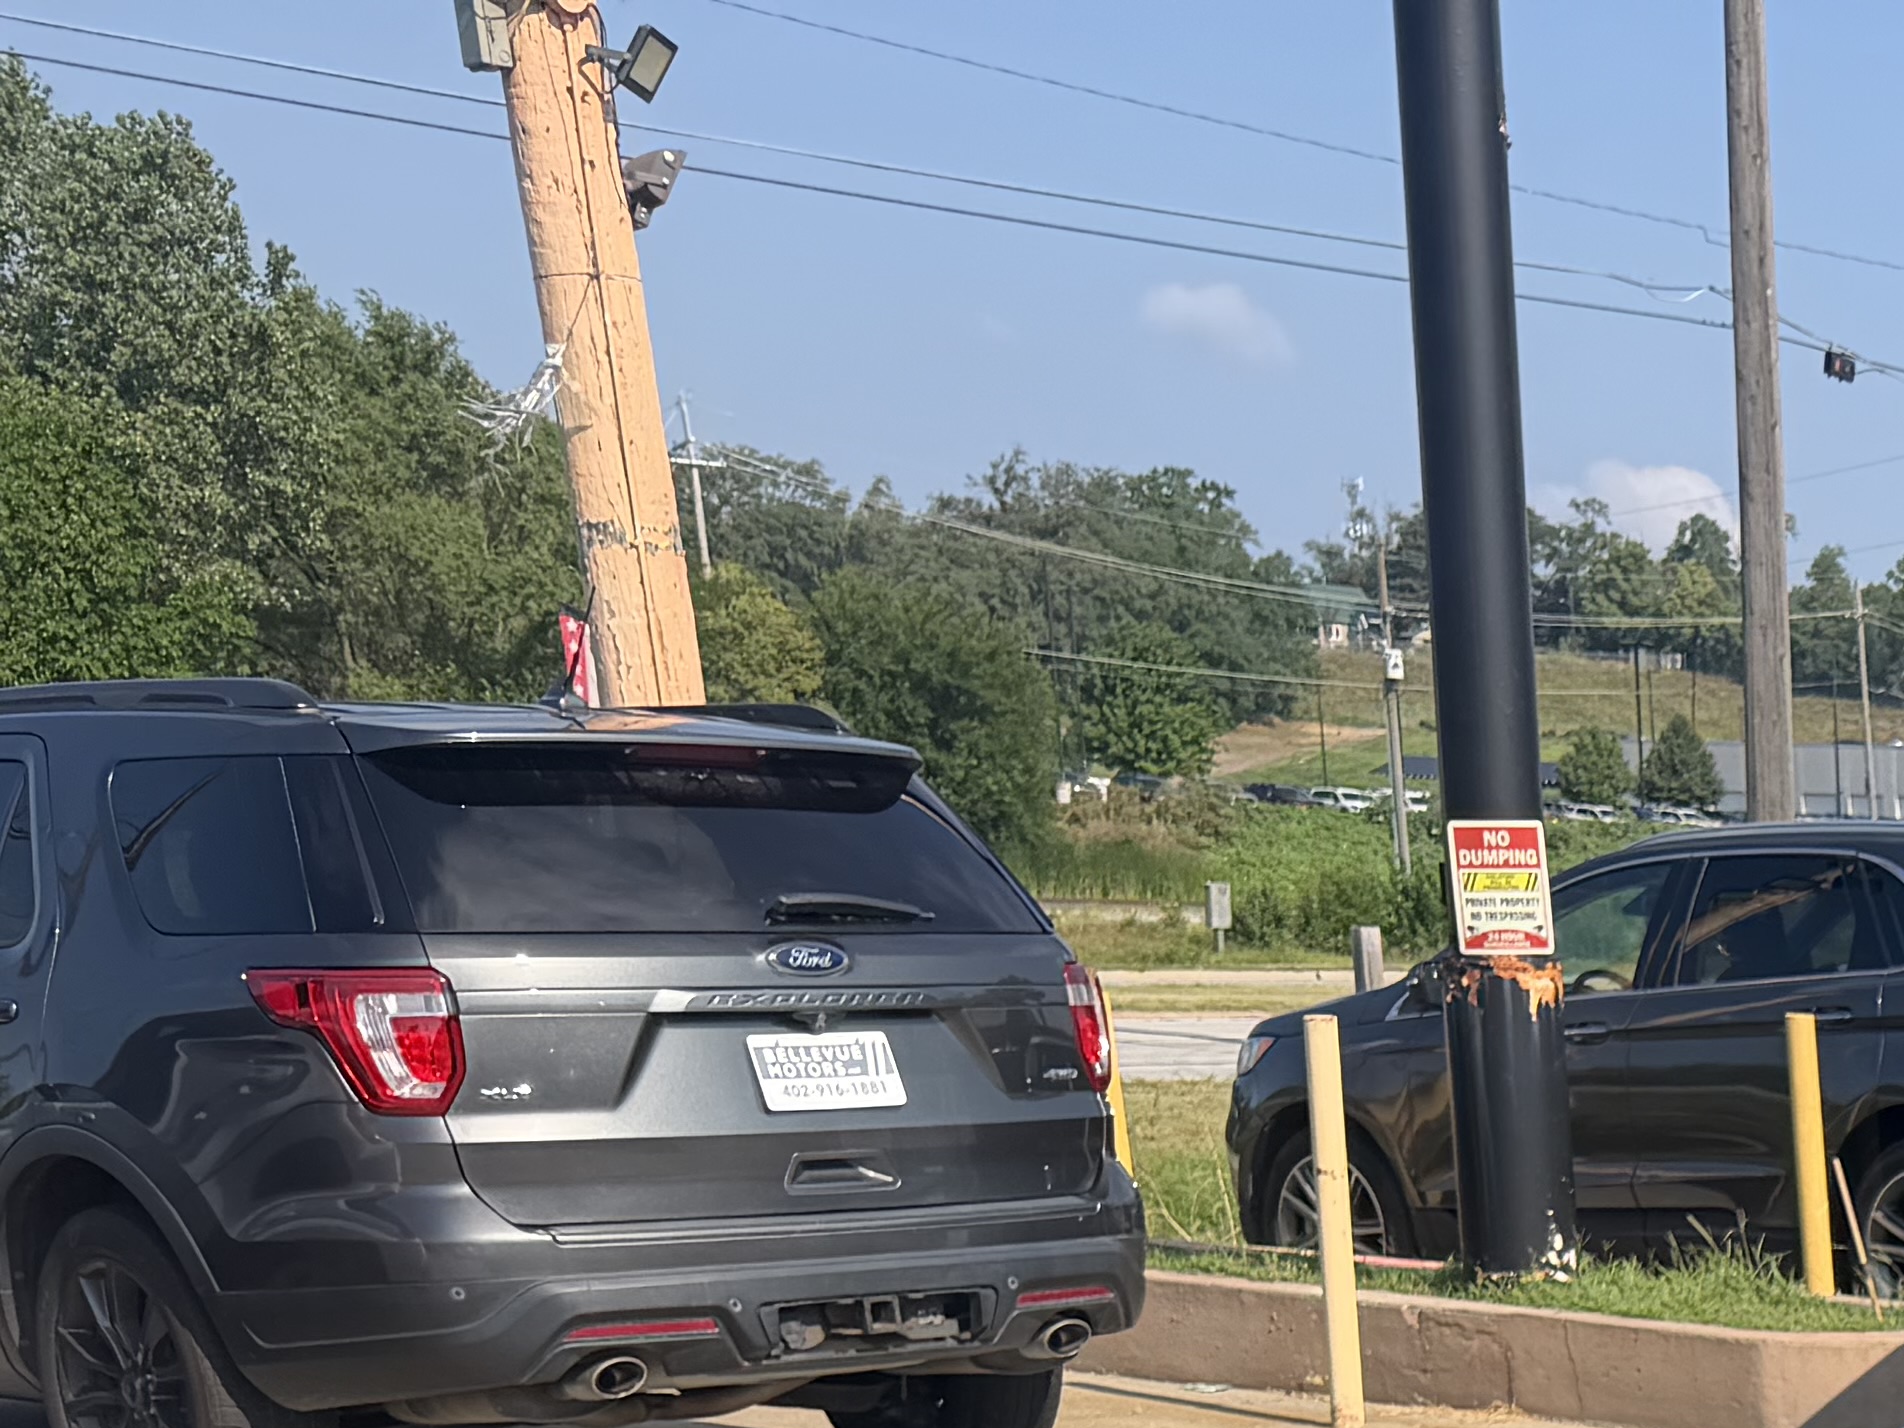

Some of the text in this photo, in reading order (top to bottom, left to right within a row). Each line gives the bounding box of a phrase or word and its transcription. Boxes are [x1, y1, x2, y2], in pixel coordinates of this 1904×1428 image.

[1483, 829, 1510, 847] NO
[1459, 848, 1538, 866] DUMPING
[1465, 897, 1539, 908] PRIVATE PROPERTY
[788, 946, 833, 968] Ford
[706, 992, 925, 1007] EXPLORER
[763, 1044, 863, 1064] BELLEVUE
[767, 1061, 846, 1079] MOTORS
